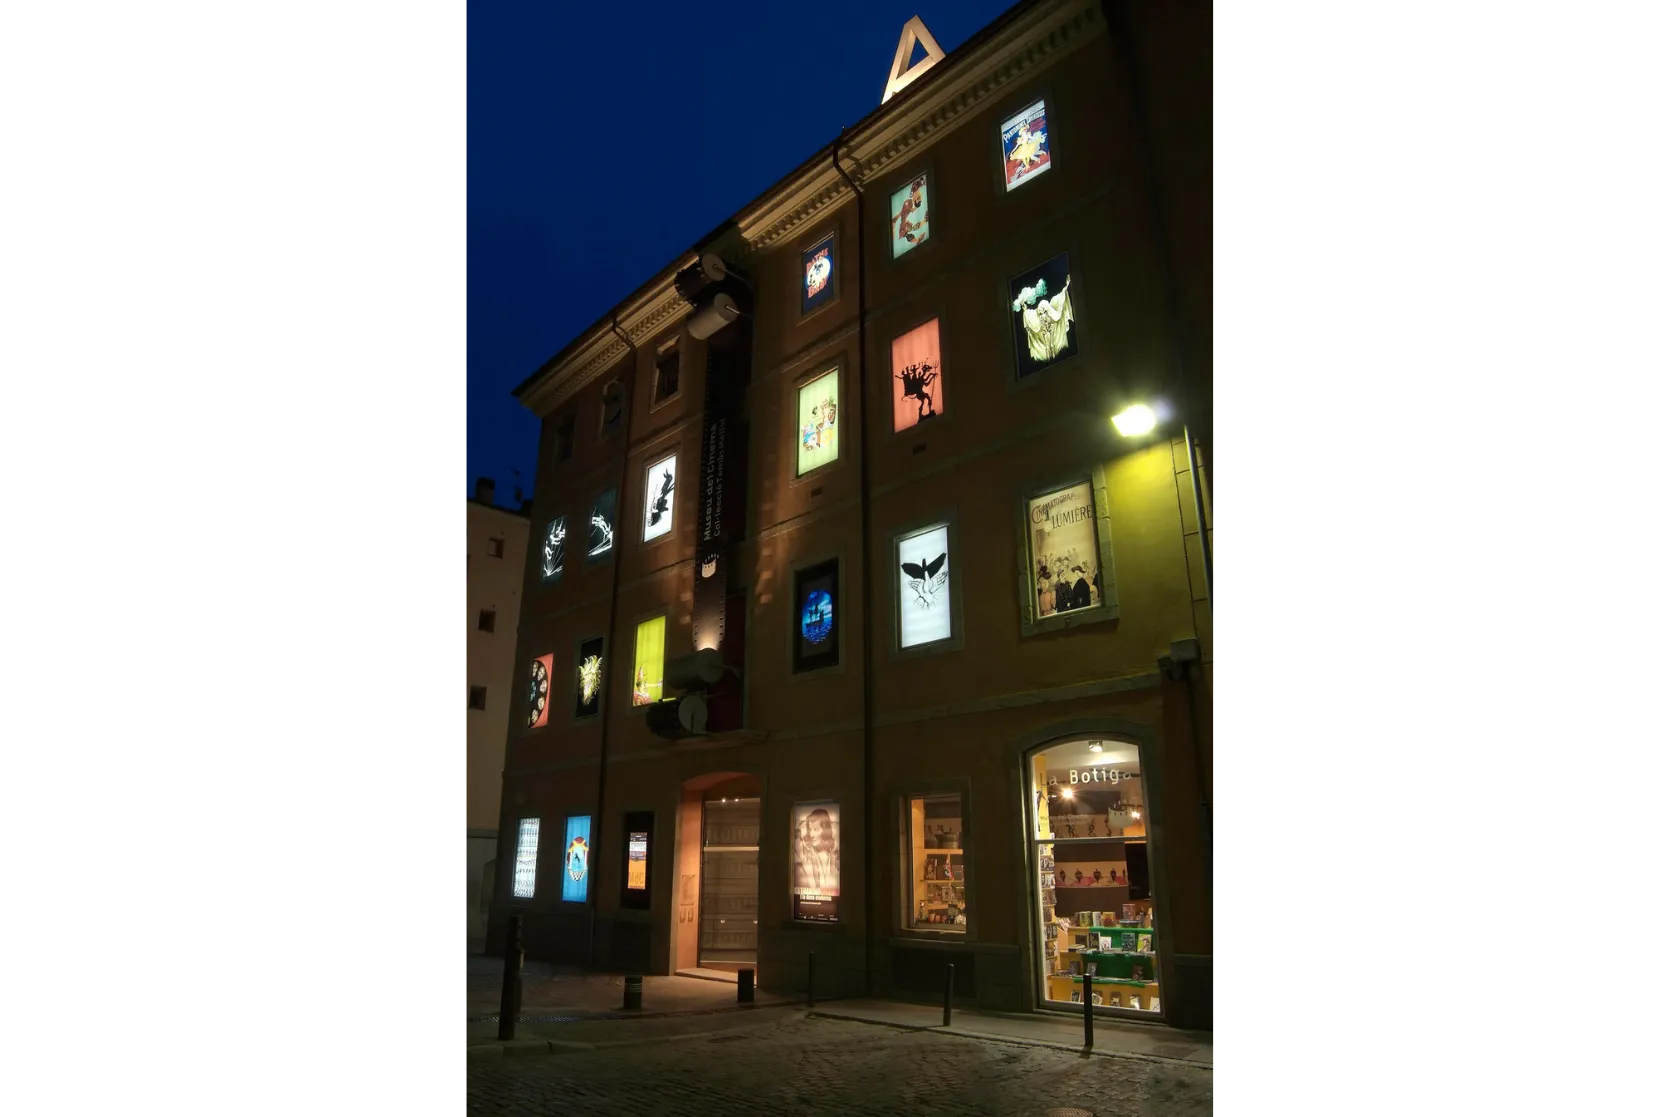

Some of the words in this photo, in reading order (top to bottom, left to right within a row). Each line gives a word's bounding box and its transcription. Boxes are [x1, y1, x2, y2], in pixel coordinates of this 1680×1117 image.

[707, 423, 717, 473] Cinema
[706, 474, 714, 495] del
[703, 497, 713, 541] Museu
[1052, 504, 1092, 529] LUMIÈRE
[1069, 767, 1133, 785] Botiga
